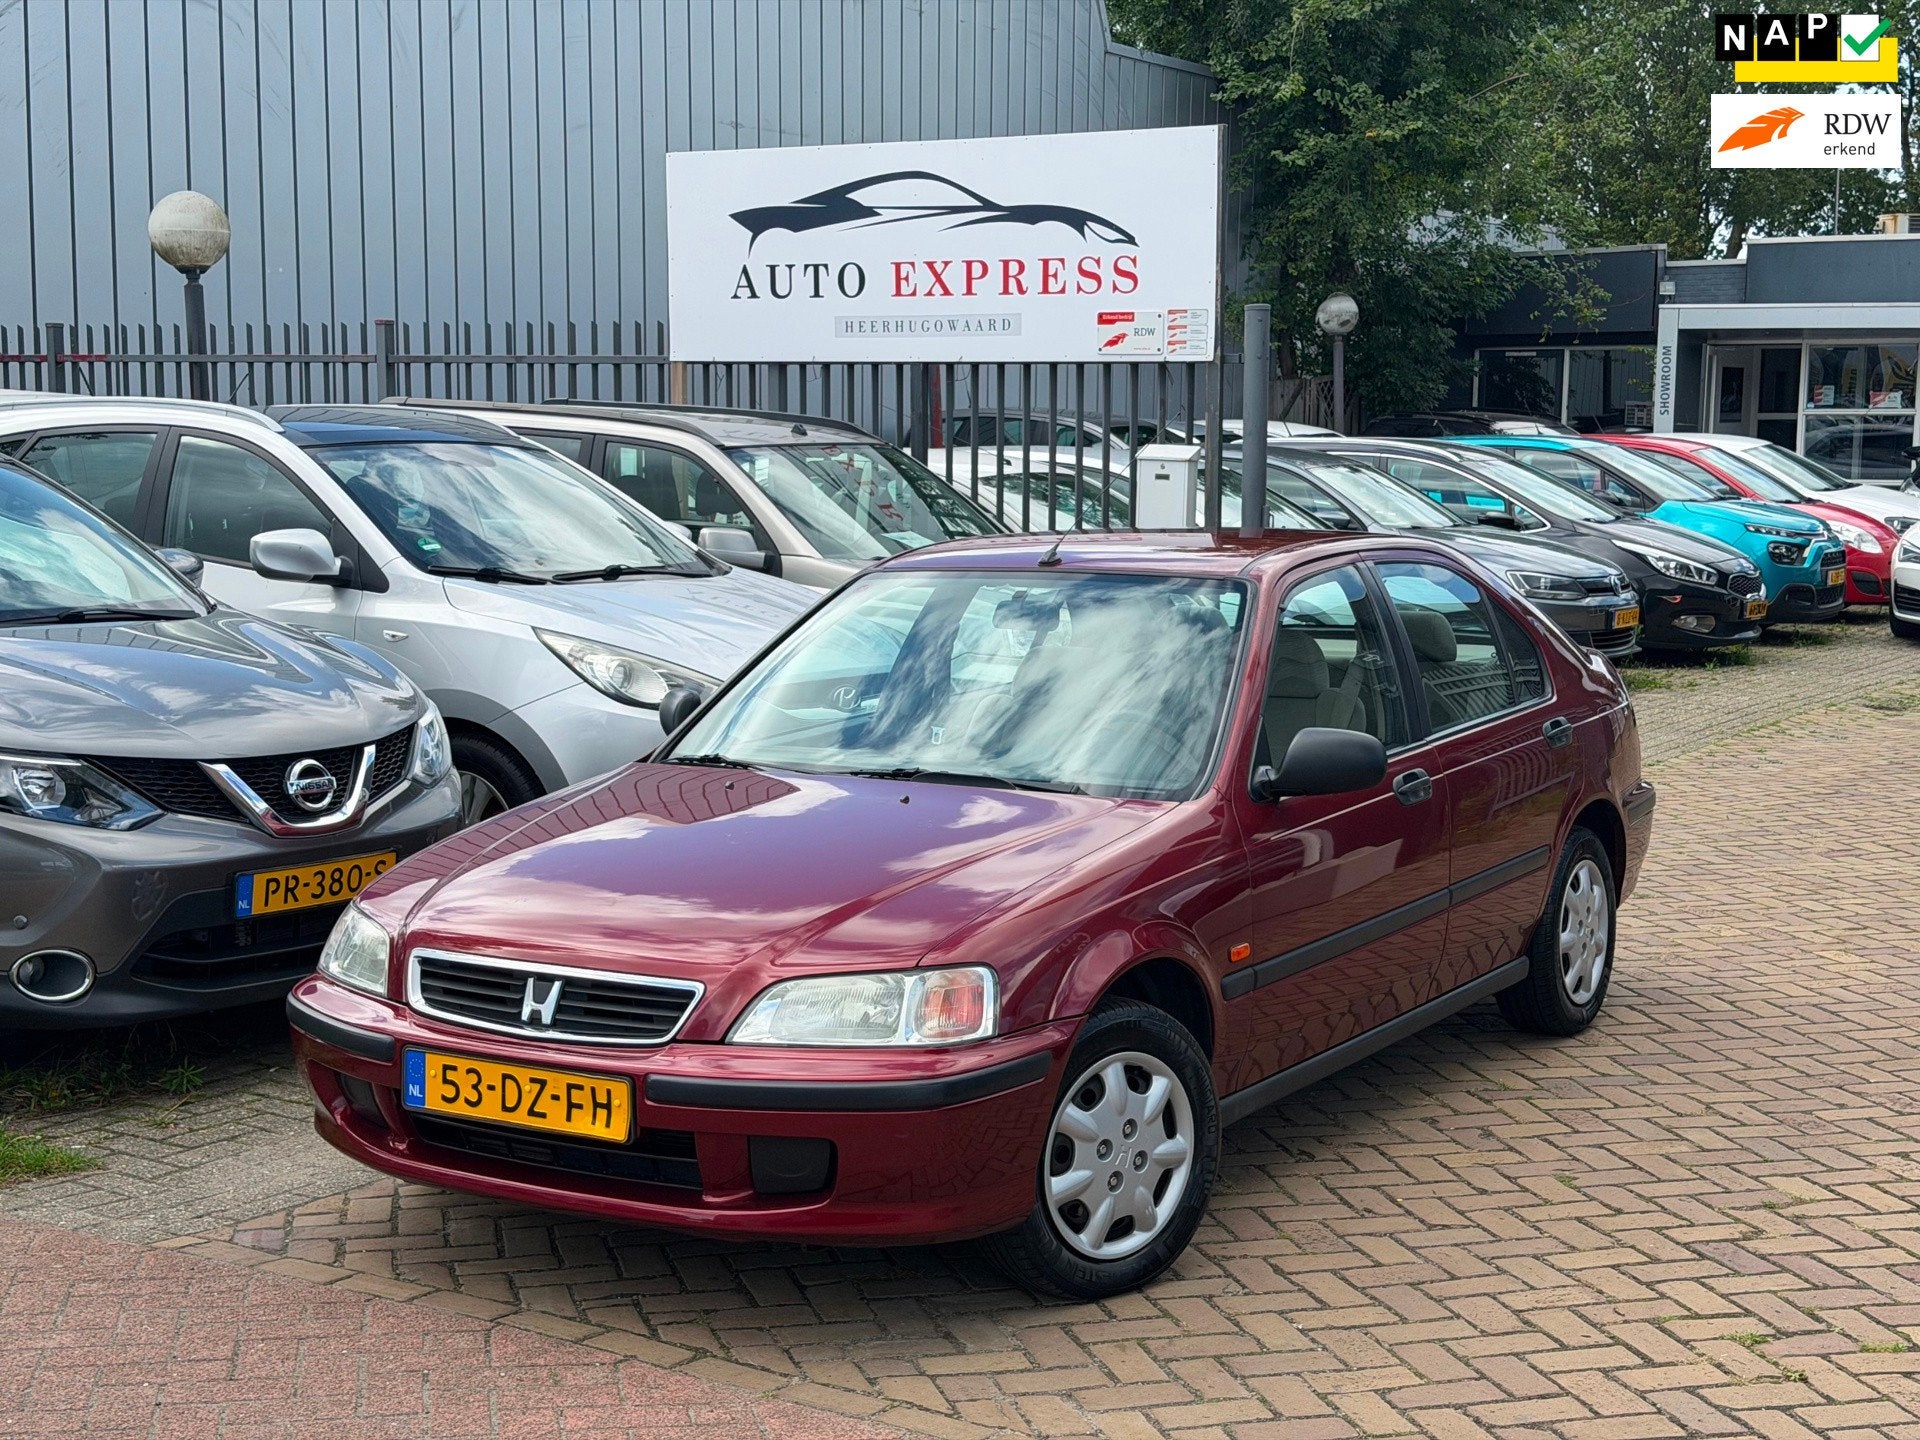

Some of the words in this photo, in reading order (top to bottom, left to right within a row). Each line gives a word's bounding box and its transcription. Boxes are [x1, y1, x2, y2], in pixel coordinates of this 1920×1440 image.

[731, 261, 866, 299] AUTO
[890, 254, 1139, 298] EXPRESS
[844, 317, 1012, 334] HEERHUGOWAARD
[1134, 327, 1156, 337] RDW
[1659, 345, 1673, 416] SHOWROOM
[295, 780, 334, 792] NISSAN
[238, 899, 250, 910] NL
[408, 1083, 424, 1098] NL
[440, 1063, 613, 1129] 53-DZ-FH
